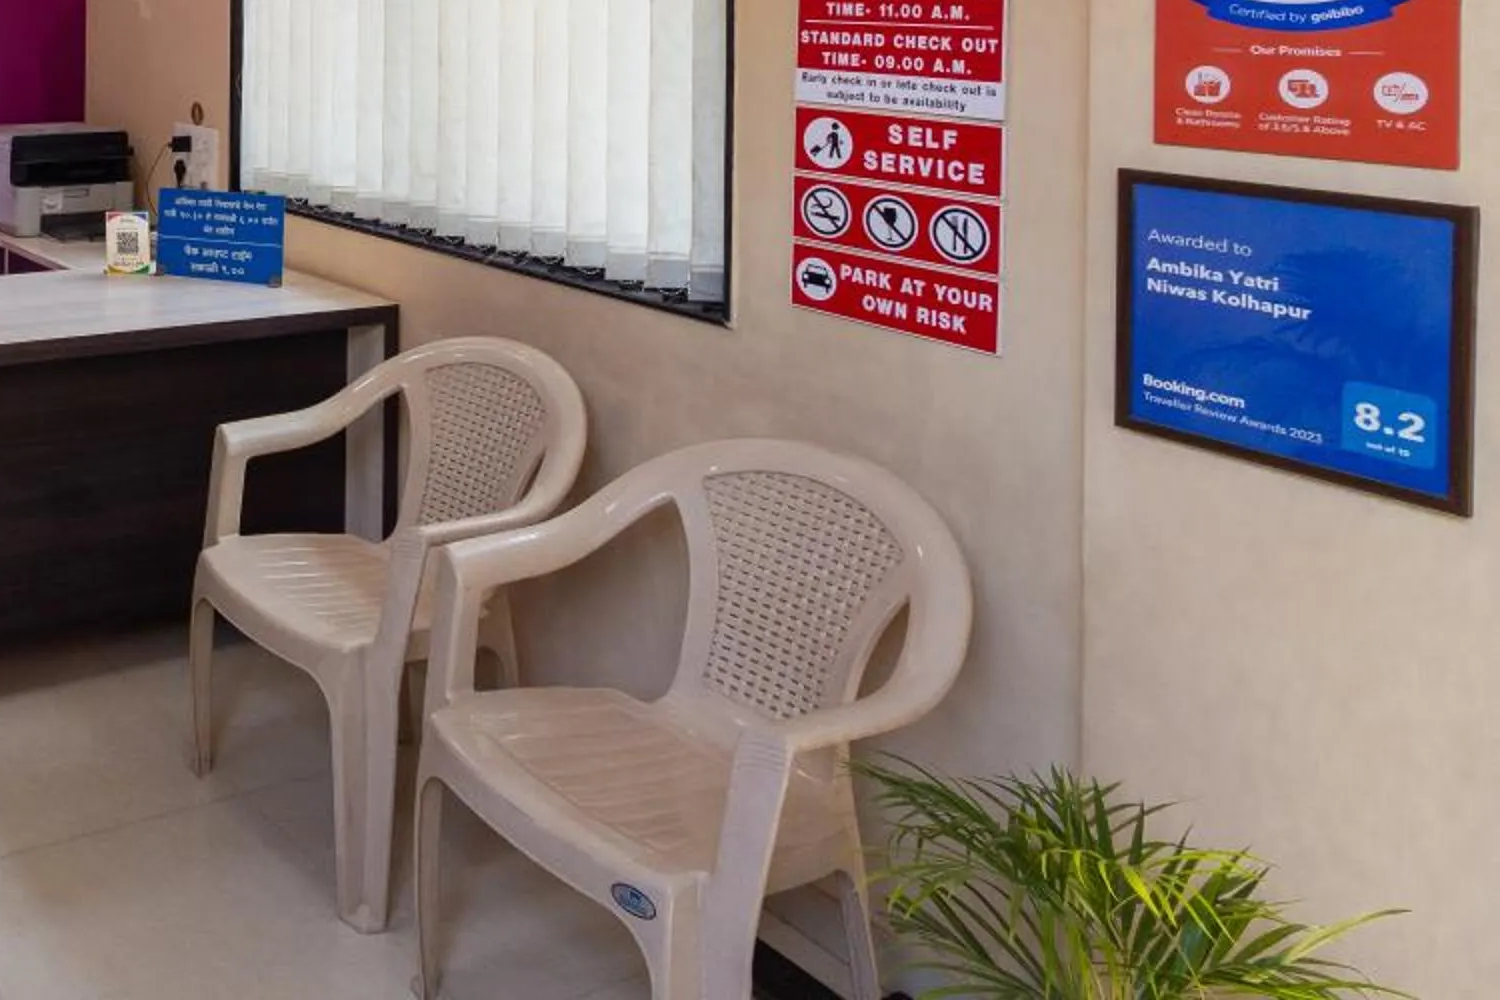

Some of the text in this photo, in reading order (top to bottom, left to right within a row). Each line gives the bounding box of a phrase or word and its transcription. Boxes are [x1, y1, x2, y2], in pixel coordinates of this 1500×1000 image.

[879, 4, 923, 18] 11.00
[931, 5, 970, 21] A.M.
[1228, 3, 1365, 24] Certified by goibibo
[800, 30, 999, 53] STANDARD CHECK OUT
[1250, 45, 1342, 57] Our Promises
[874, 55, 925, 71] 09.00
[932, 58, 972, 75] A.M.
[831, 73, 862, 86] check
[867, 76, 877, 87] in
[881, 79, 891, 89] or
[921, 80, 957, 94] check
[961, 84, 982, 95] out
[986, 86, 997, 97] is
[826, 91, 967, 112] subject to be availability
[888, 123, 958, 150] SELF
[863, 150, 986, 185] SERVICE
[1148, 228, 1253, 257] Awarded to
[840, 263, 994, 312] PARK AT YOUR
[1146, 257, 1280, 292] Ambika Yatri
[1147, 277, 1312, 321] Niwas Kolhapur
[862, 294, 967, 334] OWN RISK
[1143, 373, 1245, 408] Booking.com
[1143, 392, 1323, 445] Traveller Review Awards 2023
[1354, 401, 1425, 443] 8.2
